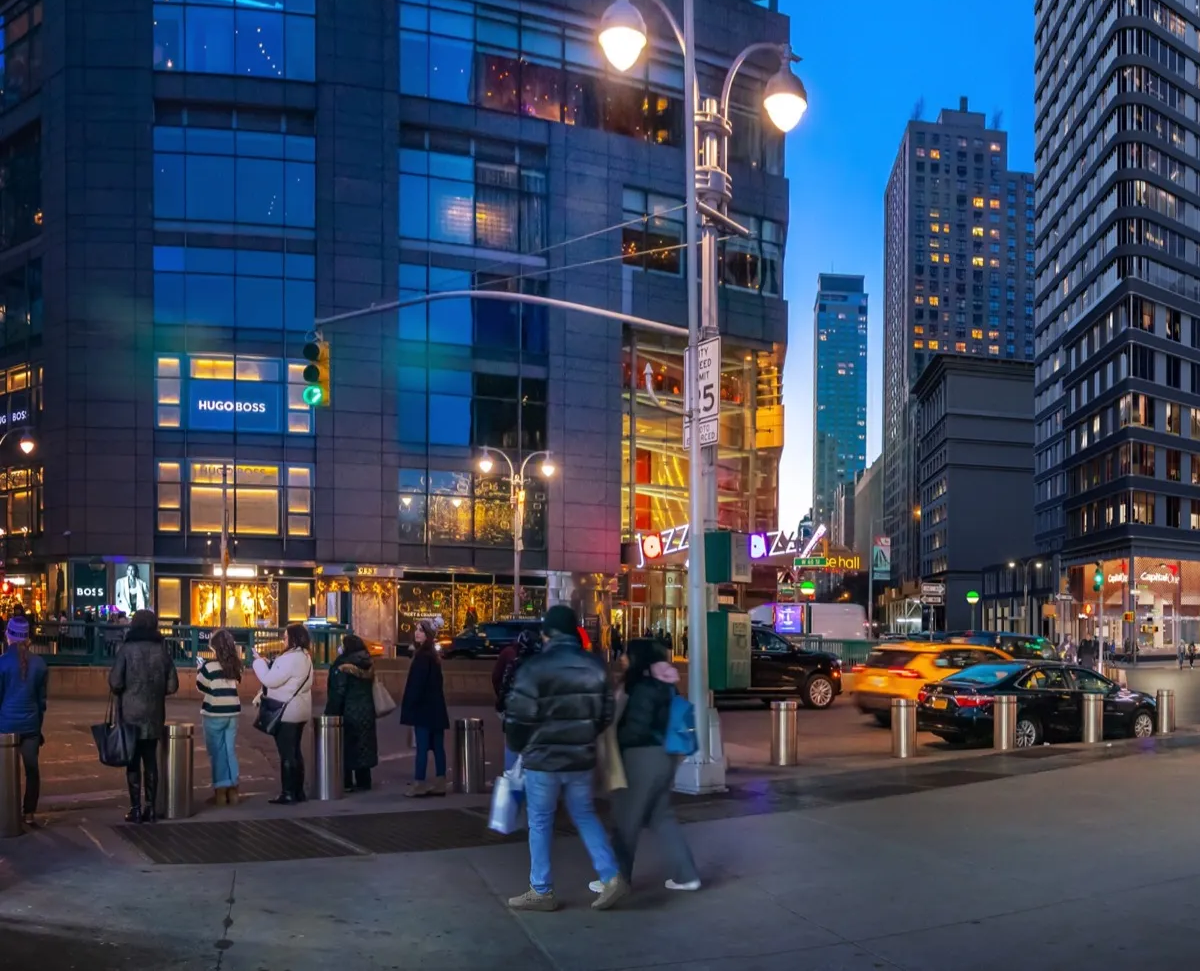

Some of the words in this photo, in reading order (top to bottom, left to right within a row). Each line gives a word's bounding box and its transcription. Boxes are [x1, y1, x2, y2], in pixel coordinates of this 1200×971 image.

[699, 358, 712, 369] EED
[699, 370, 710, 381] MIT
[699, 383, 715, 413] 5
[198, 400, 234, 412] HUGO
[235, 402, 266, 413] BOSS
[838, 555, 860, 569] hall
[76, 587, 104, 597] BOSS
